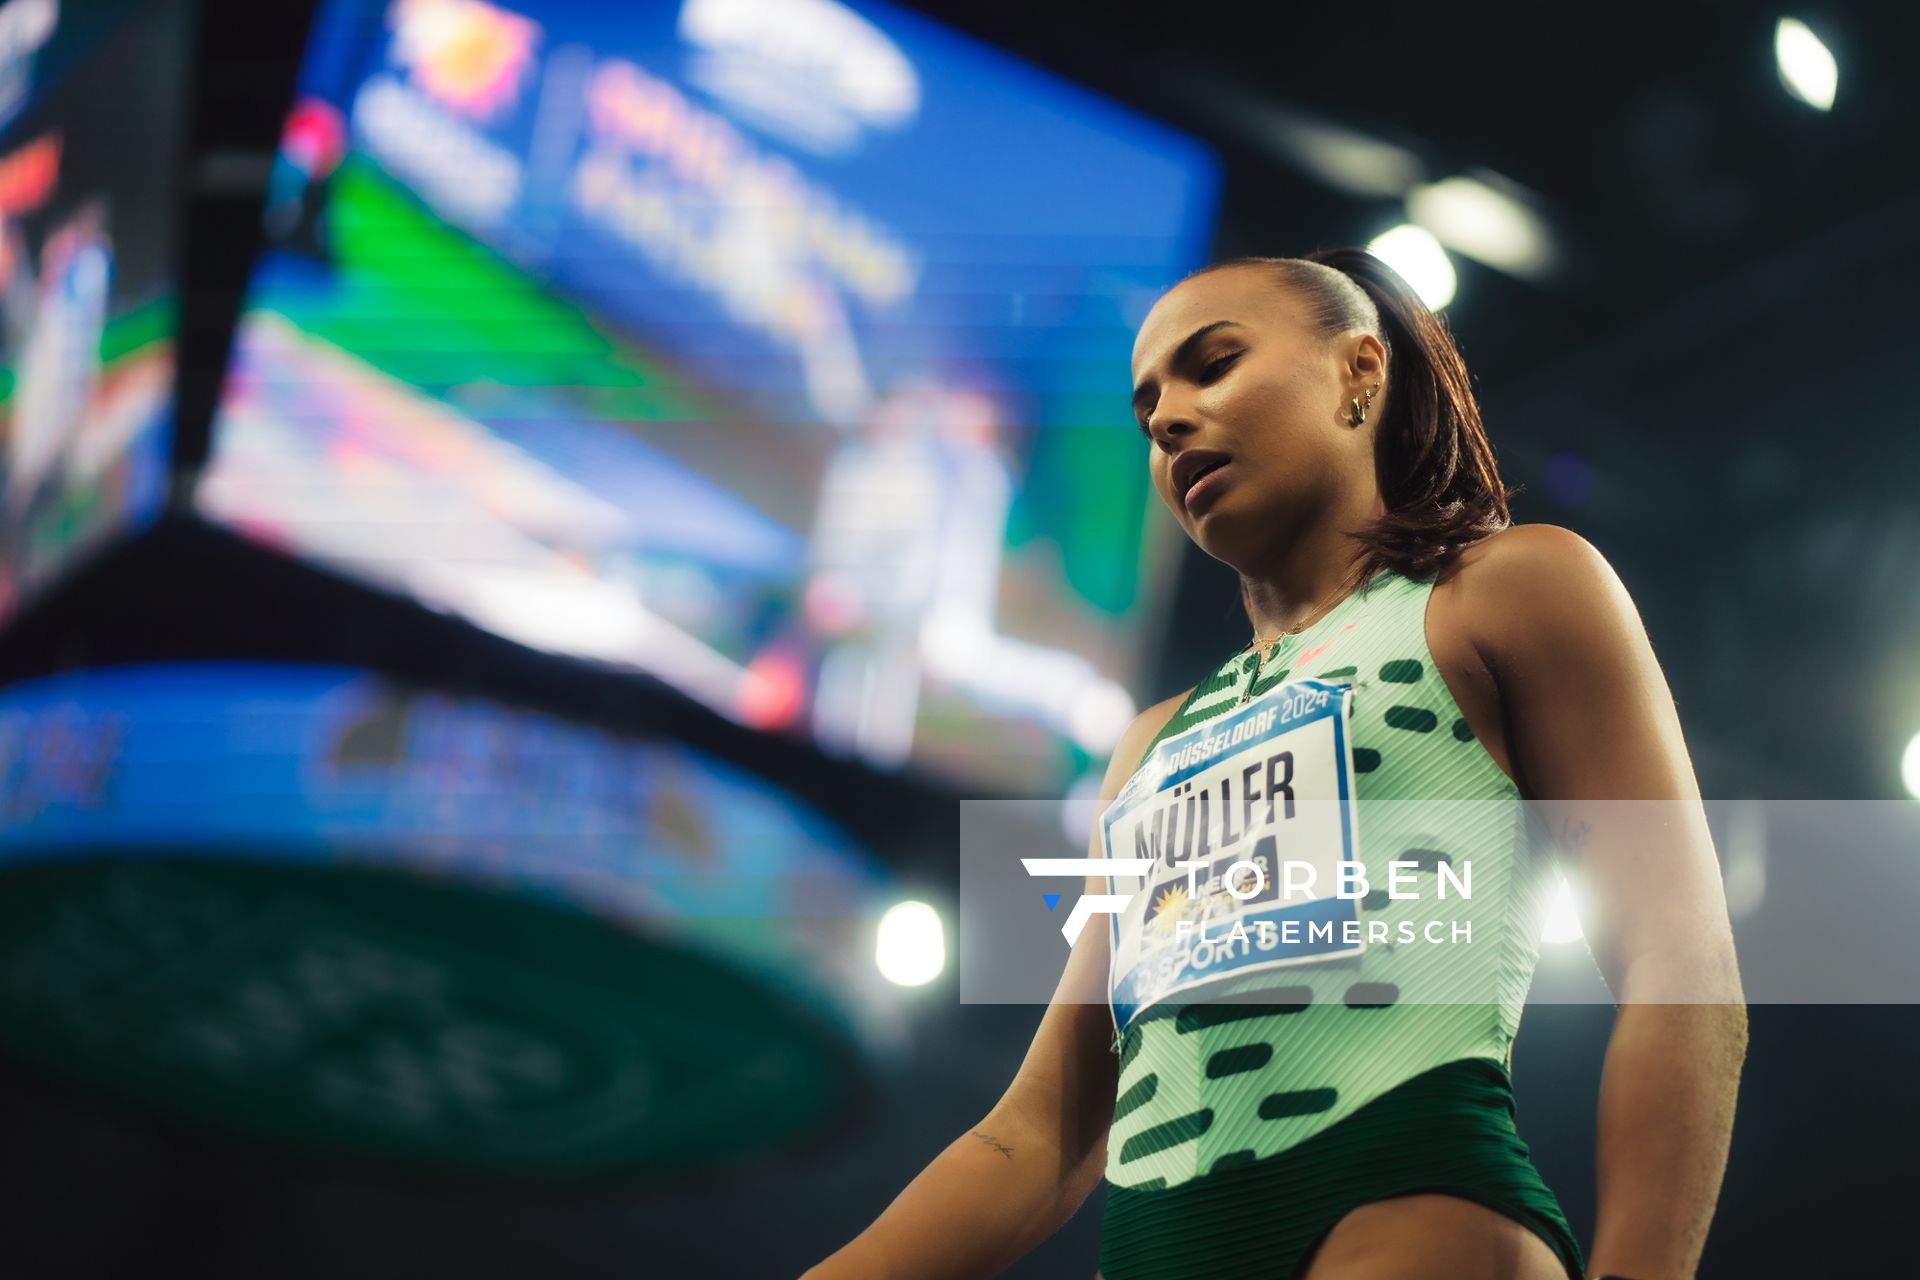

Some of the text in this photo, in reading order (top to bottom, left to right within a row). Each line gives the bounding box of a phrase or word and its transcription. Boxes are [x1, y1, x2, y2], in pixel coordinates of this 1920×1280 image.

[1166, 689, 1330, 776] DÜSSELDORF 2024
[1134, 751, 1296, 892] MÜLLER
